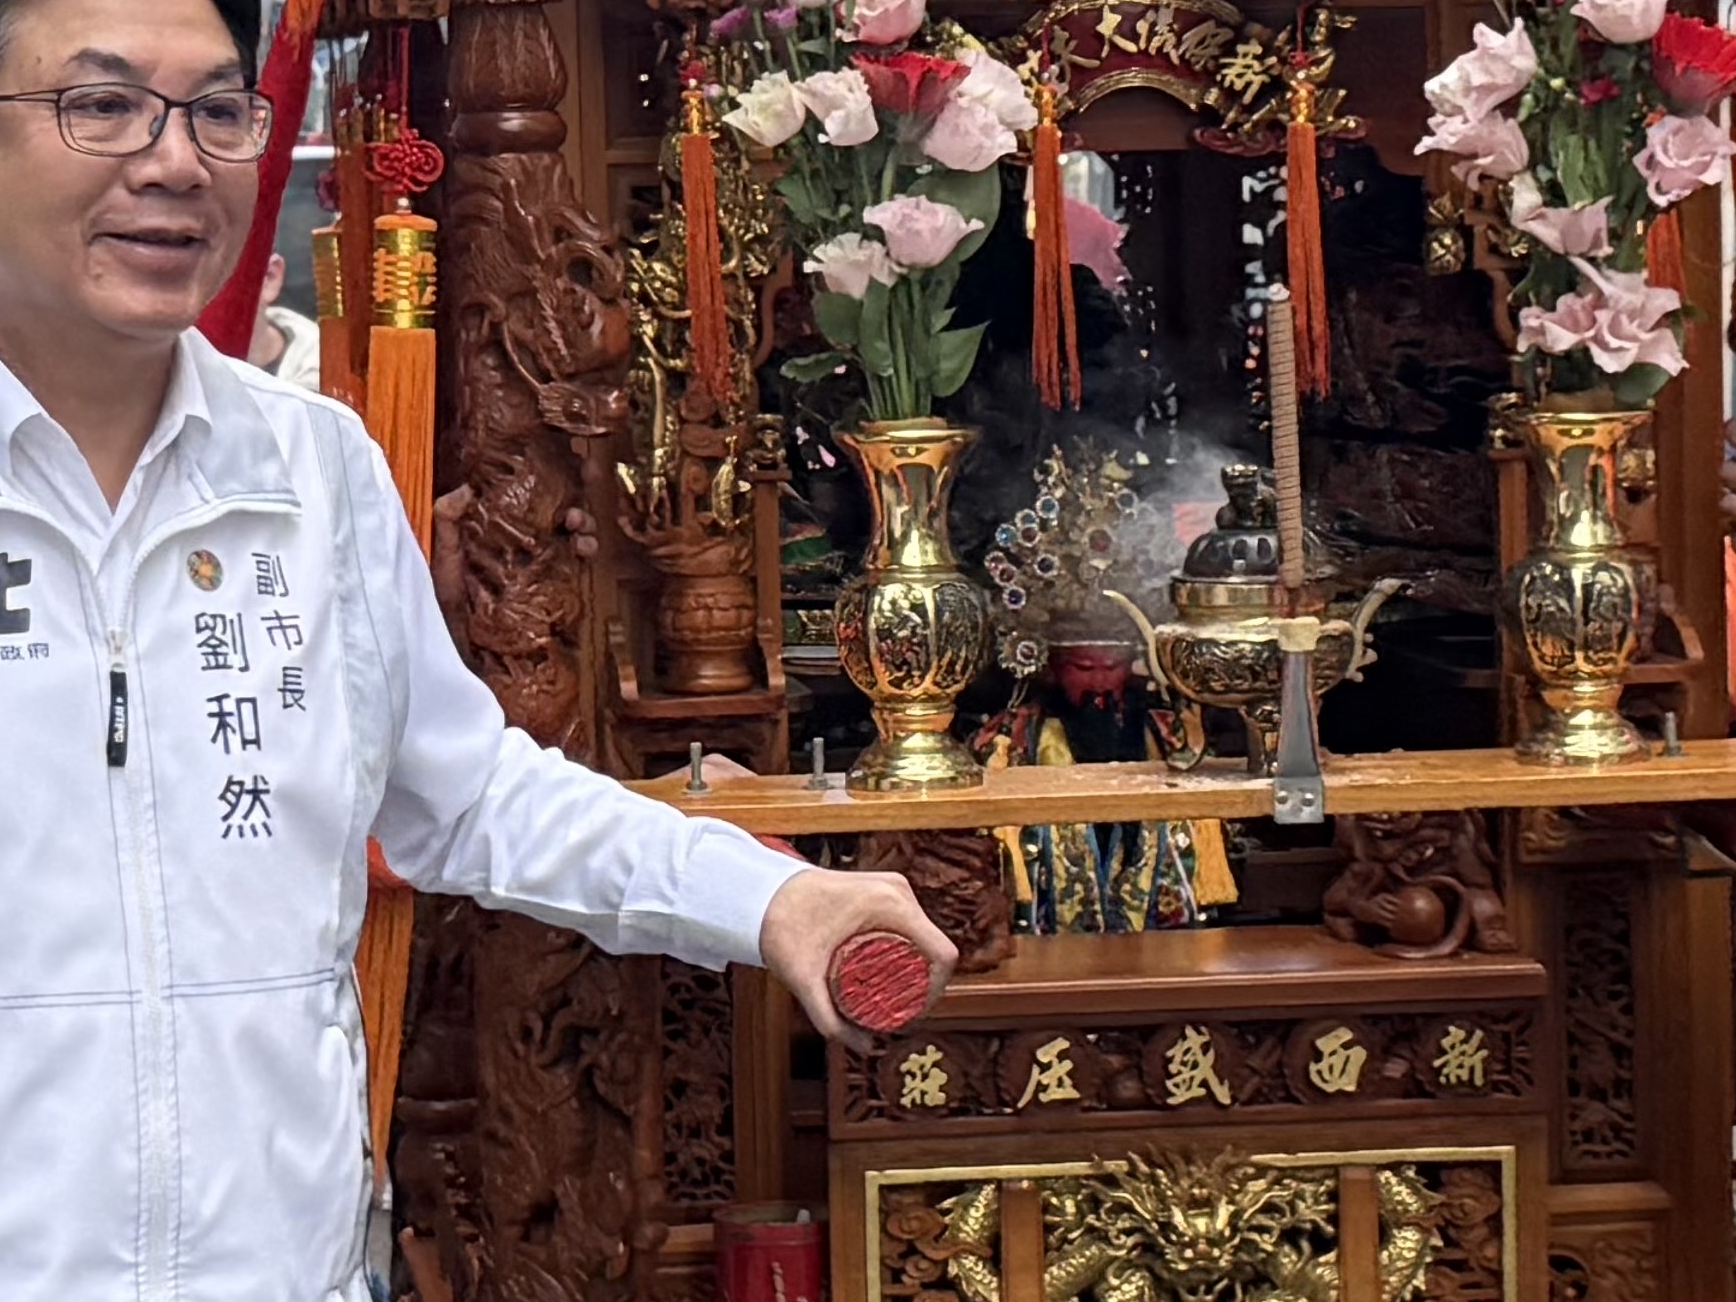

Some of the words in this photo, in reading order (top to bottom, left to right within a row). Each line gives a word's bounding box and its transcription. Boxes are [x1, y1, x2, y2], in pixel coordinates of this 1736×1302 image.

[194, 611, 273, 840] 劉和然
[251, 551, 307, 712] 副市長
